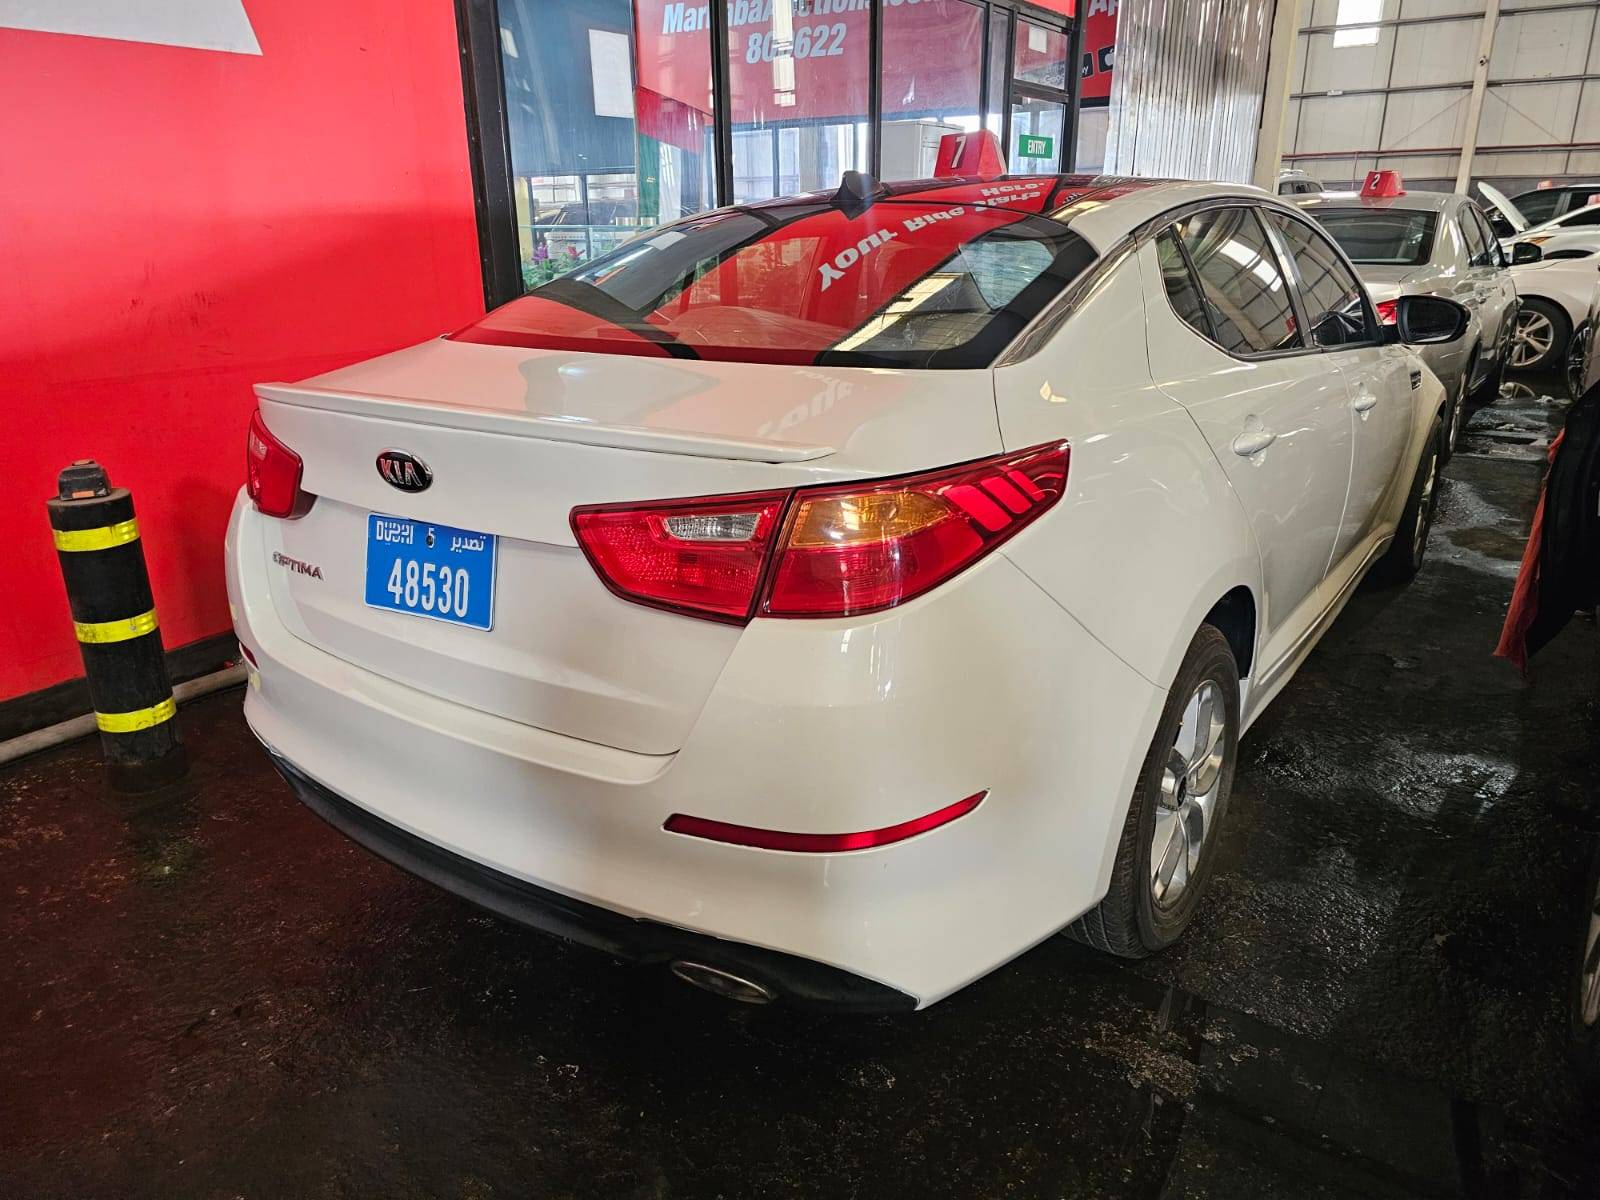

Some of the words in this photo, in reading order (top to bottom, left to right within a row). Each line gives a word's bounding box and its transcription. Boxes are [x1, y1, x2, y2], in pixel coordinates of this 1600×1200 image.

[745, 23, 847, 64] 80622
[951, 135, 967, 169] 7
[1027, 138, 1046, 155] ENTRY
[1370, 173, 1381, 190] 2
[379, 458, 423, 487] KIA
[272, 550, 324, 582] OPTIMA
[387, 558, 470, 618] 48530
